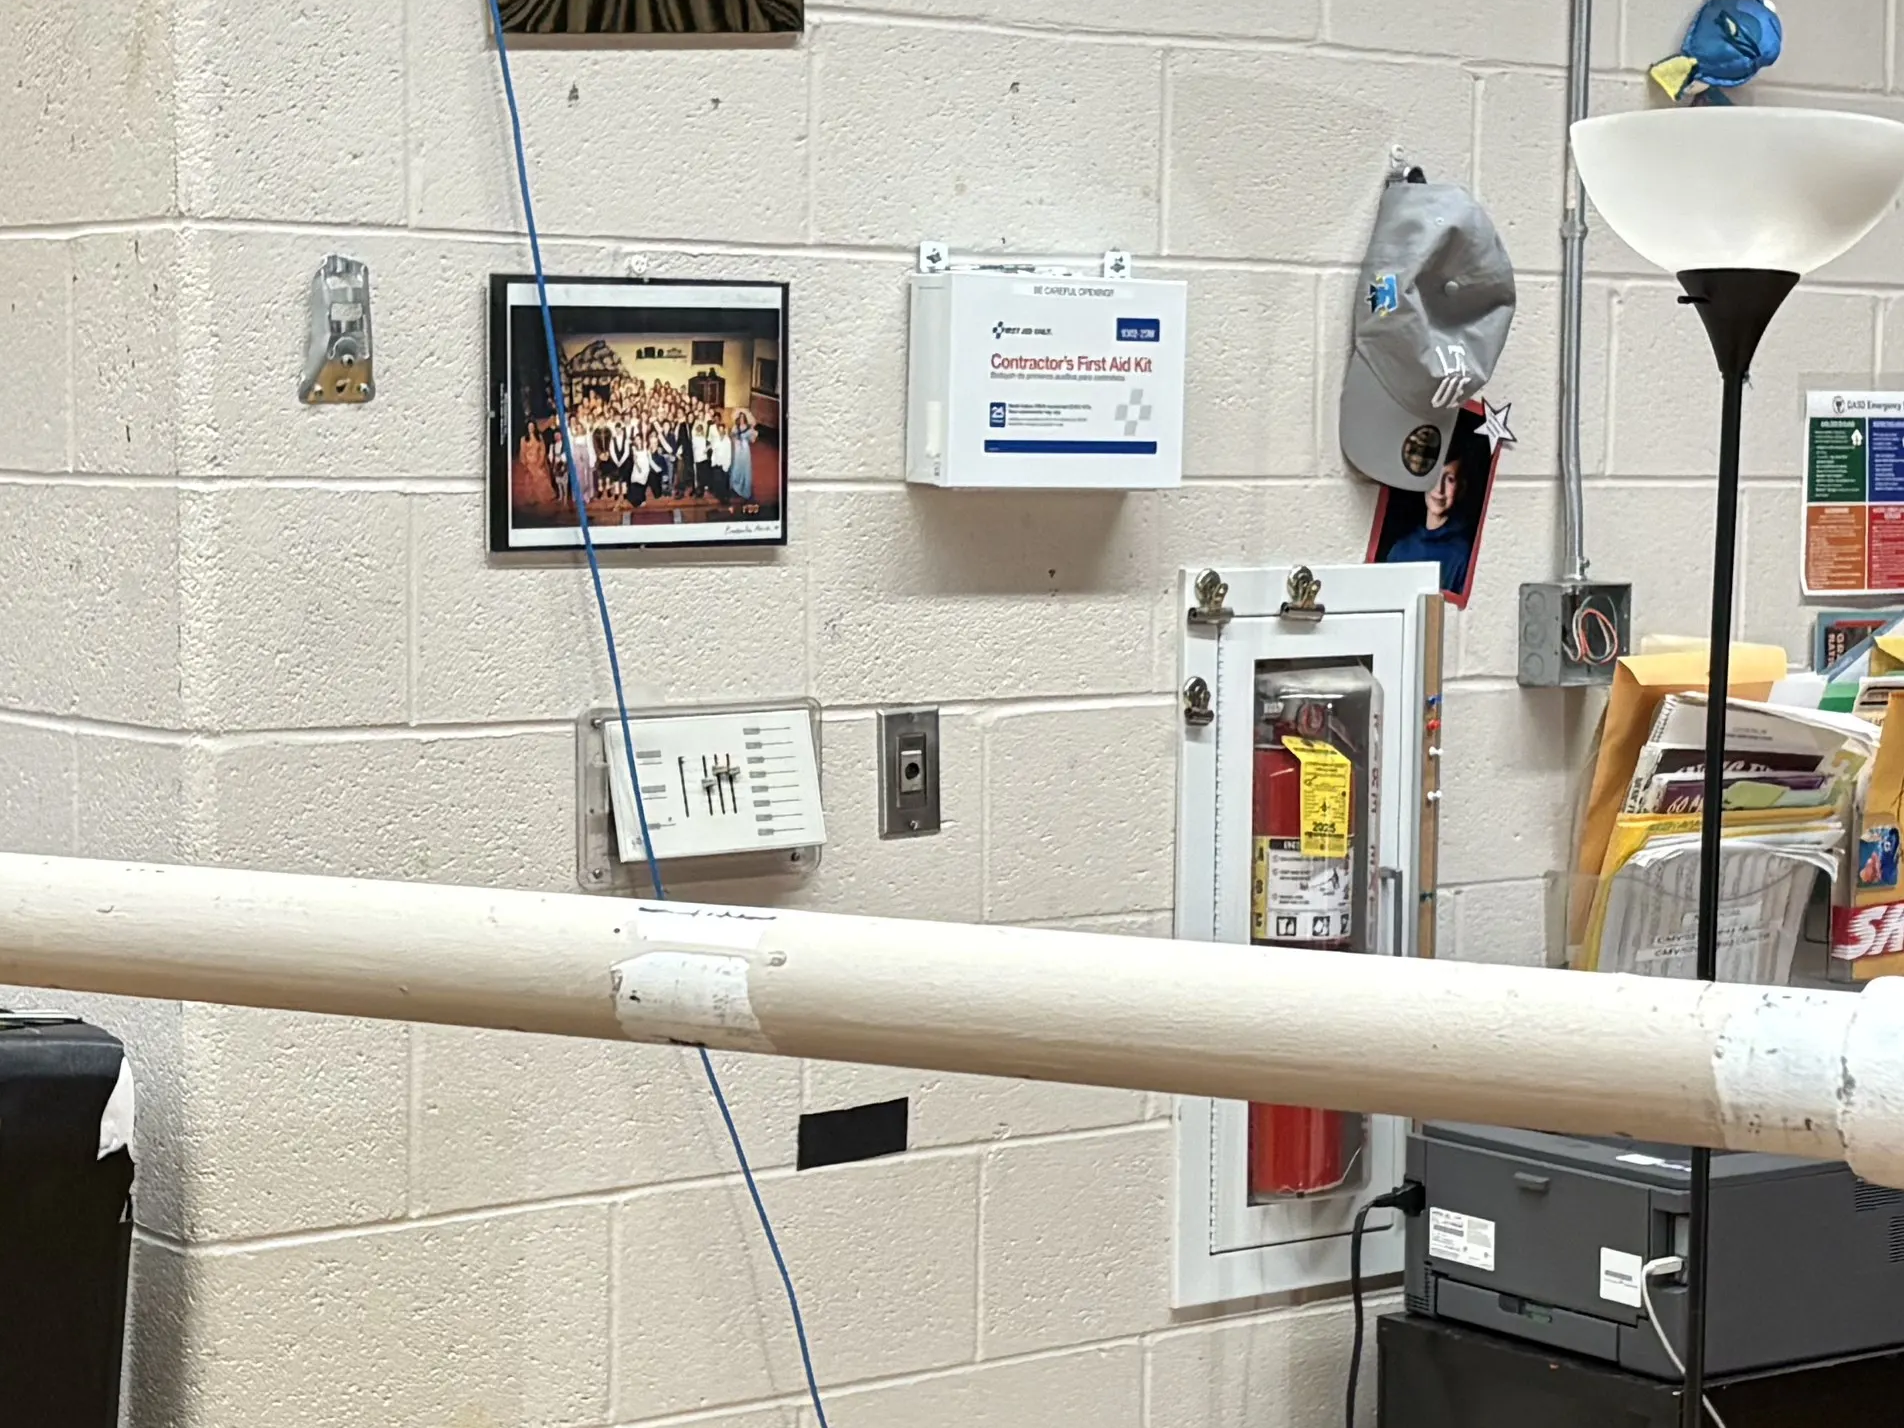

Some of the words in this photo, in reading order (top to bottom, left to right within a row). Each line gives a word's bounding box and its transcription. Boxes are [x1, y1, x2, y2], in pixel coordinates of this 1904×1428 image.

[991, 353, 1074, 371] Contractor's
[1078, 356, 1105, 371] First
[1109, 357, 1130, 371] Aid
[1135, 358, 1152, 372] Kit
